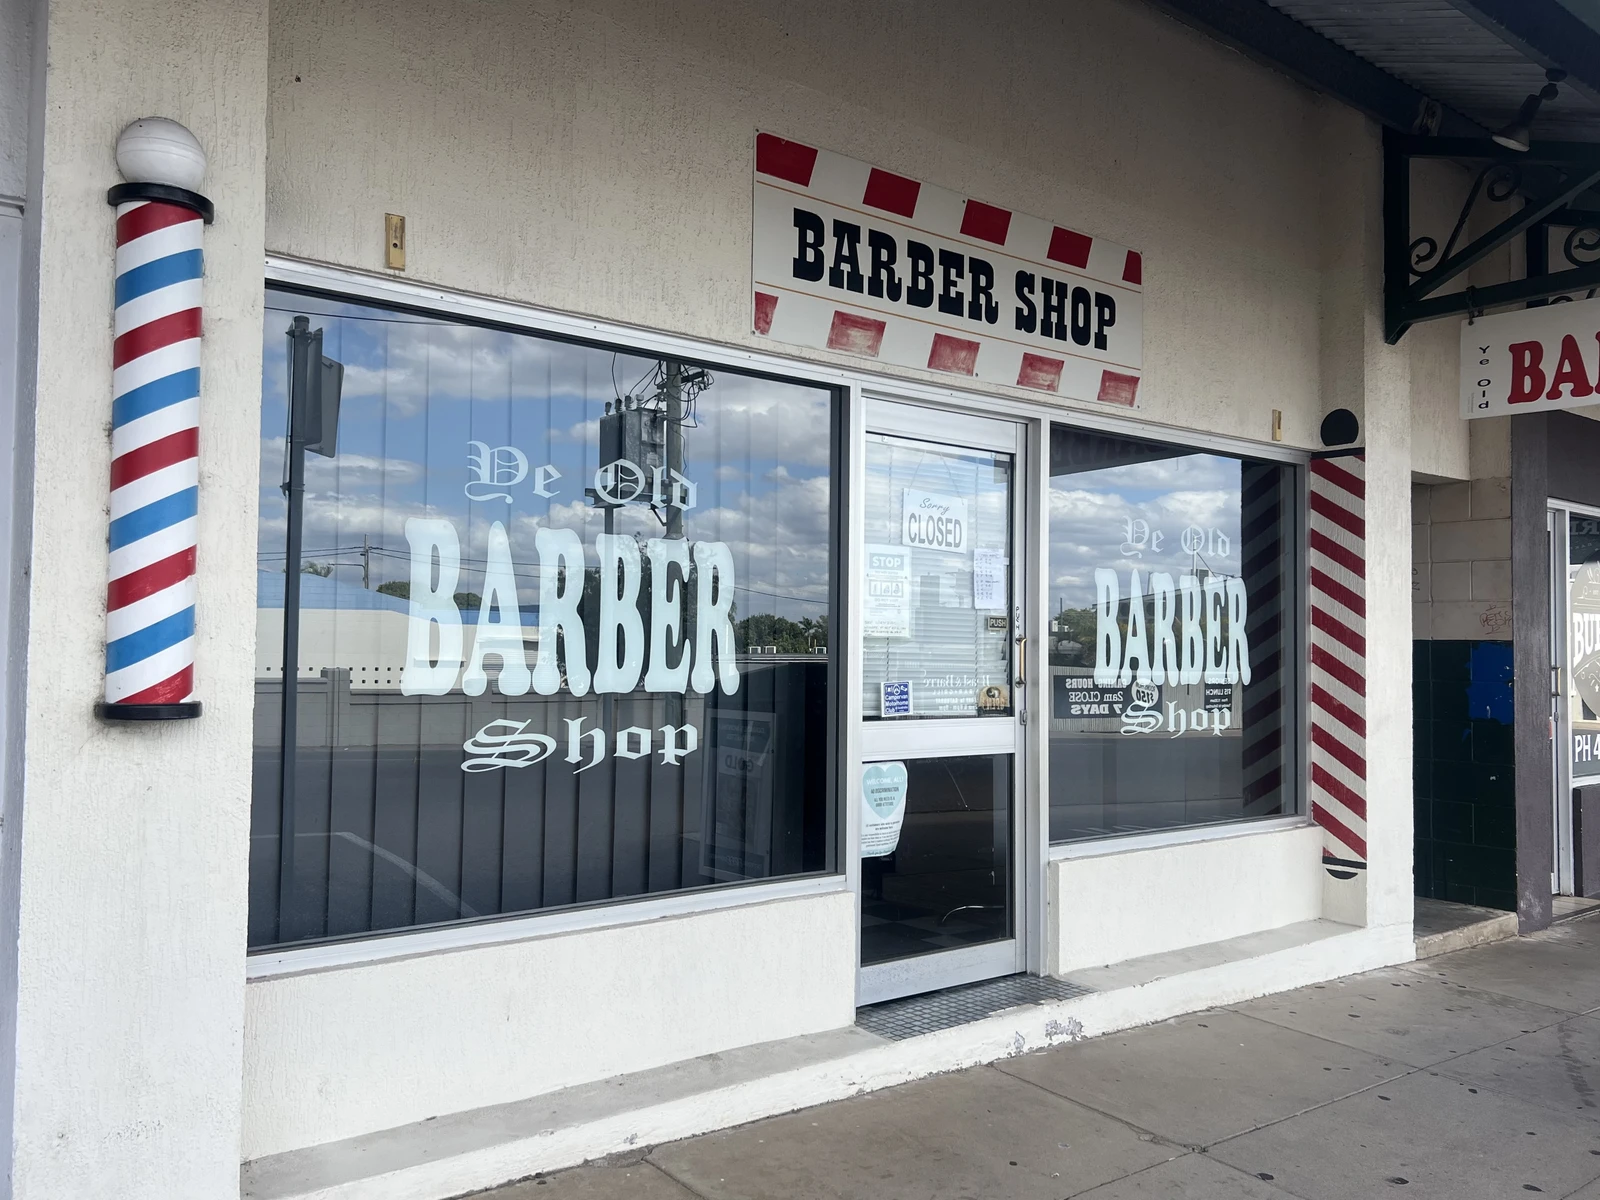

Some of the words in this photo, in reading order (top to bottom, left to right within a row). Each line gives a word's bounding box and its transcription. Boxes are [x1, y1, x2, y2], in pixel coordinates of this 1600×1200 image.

[792, 207, 999, 325] BARBER
[1015, 270, 1116, 351] SHOP
[1479, 345, 1490, 366] Ye
[1507, 330, 1600, 404] BA
[1477, 379, 1491, 409] Old
[465, 440, 562, 504] Ye
[594, 458, 698, 512] Old
[919, 498, 950, 515] Sorry
[908, 512, 962, 548] CLOSED
[1120, 515, 1164, 559] Ye
[1181, 524, 1231, 558] Old
[872, 556, 901, 568] STOP
[401, 517, 740, 697] BARBER
[990, 618, 1006, 627] PUSH
[1094, 567, 1251, 687] BARBER
[1120, 701, 1231, 739] Shop
[461, 716, 698, 774] Shop
[1574, 734, 1591, 763] PH
